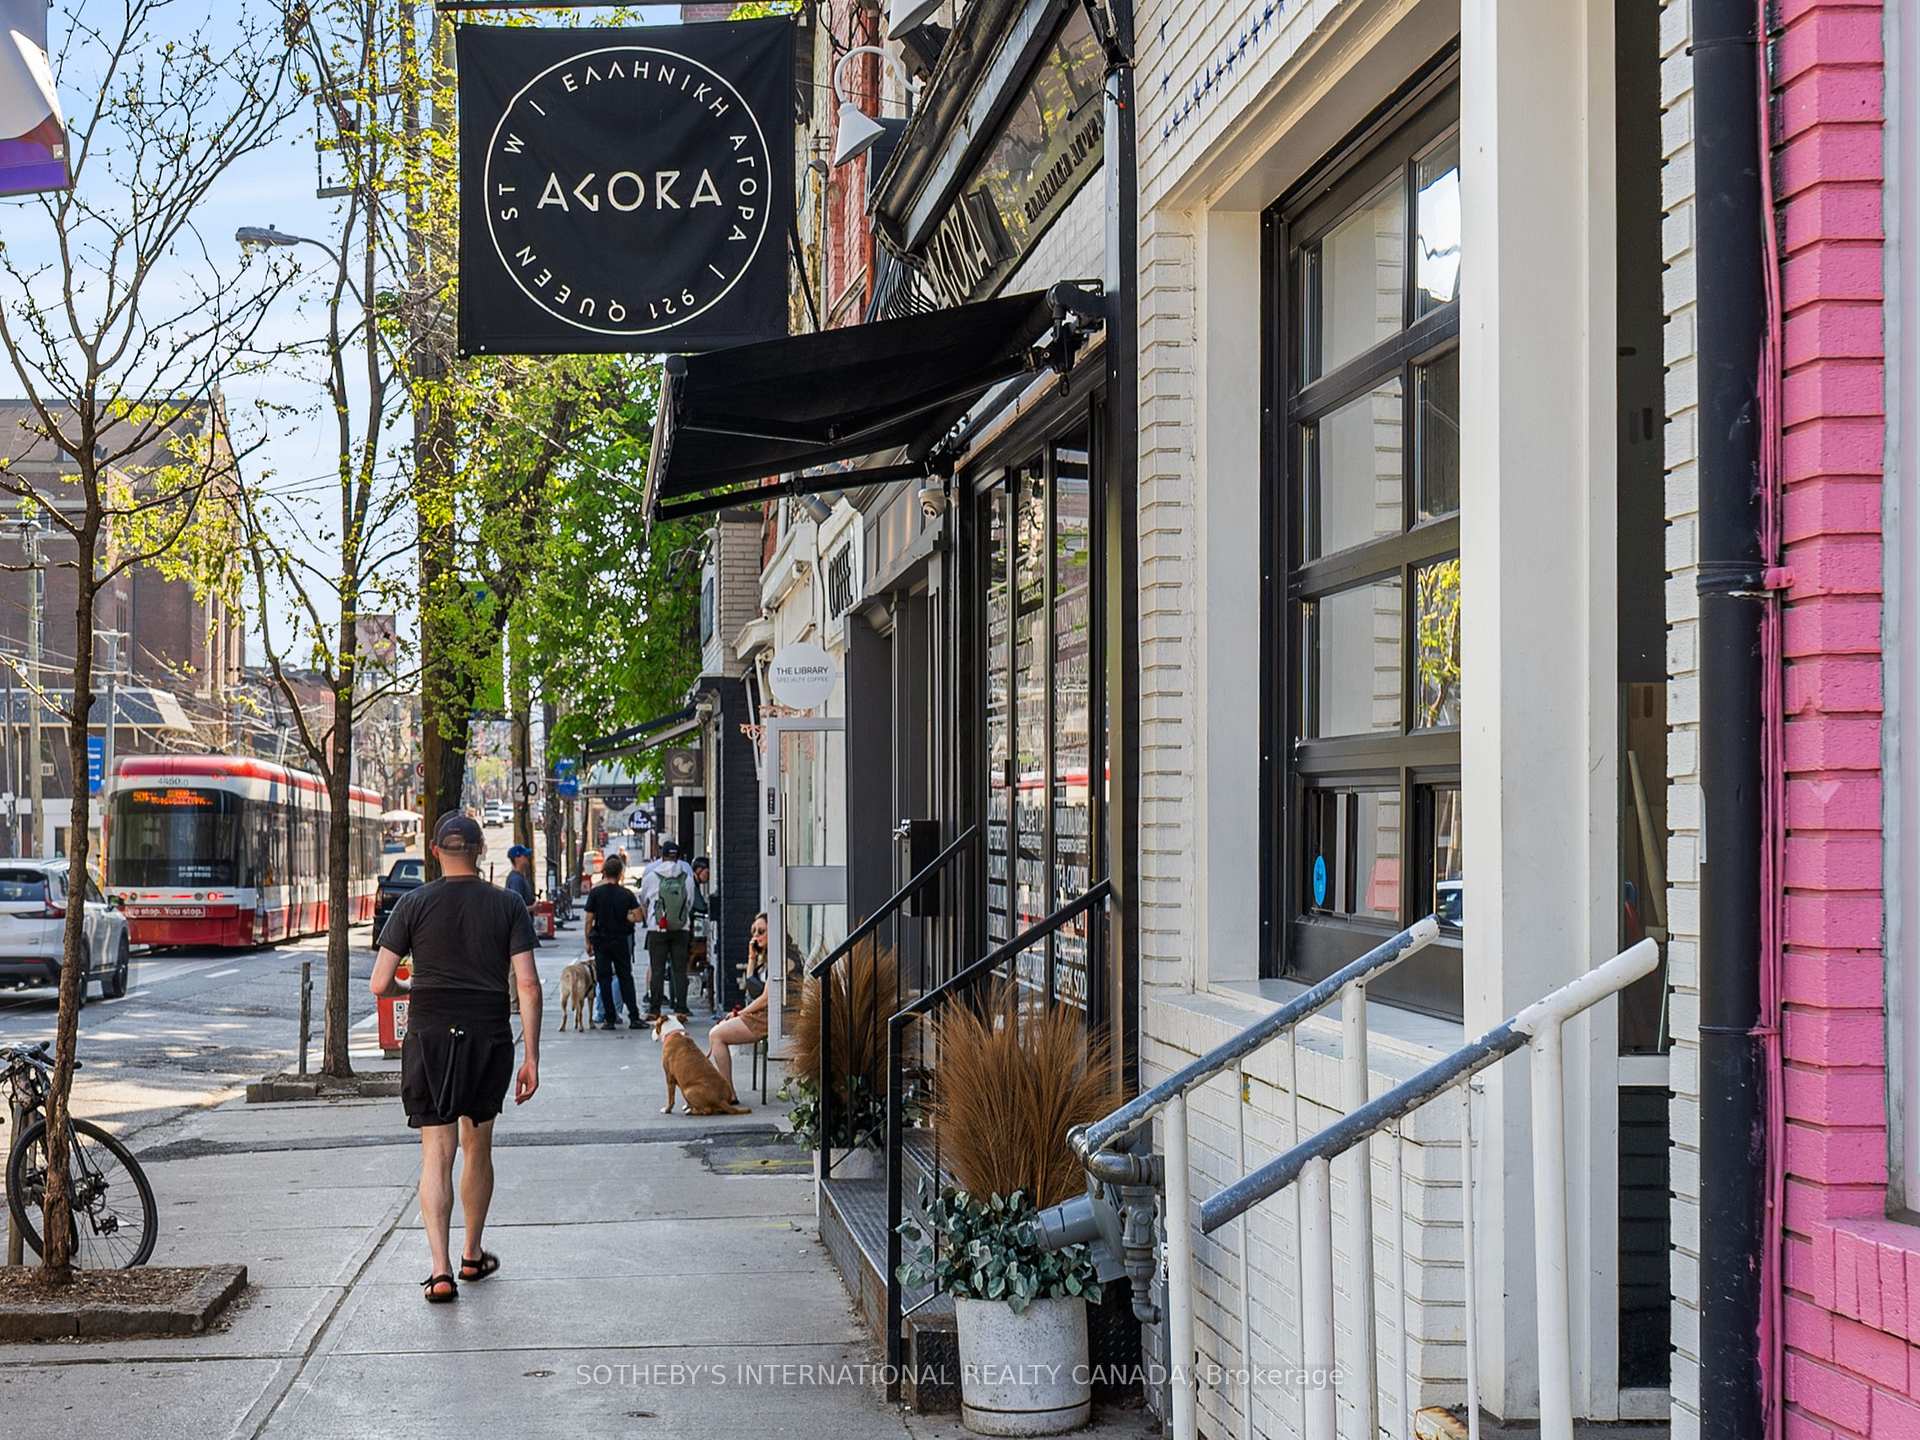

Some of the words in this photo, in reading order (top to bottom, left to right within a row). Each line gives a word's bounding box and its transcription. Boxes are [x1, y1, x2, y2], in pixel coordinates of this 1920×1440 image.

[503, 133, 526, 155] W
[498, 183, 520, 221] ST
[536, 168, 723, 213] AGORA
[515, 244, 627, 323] QUEEN
[648, 288, 696, 321] 921
[776, 666, 793, 676] THE
[794, 665, 829, 675] LIBRARY
[182, 907, 203, 917] stop.
